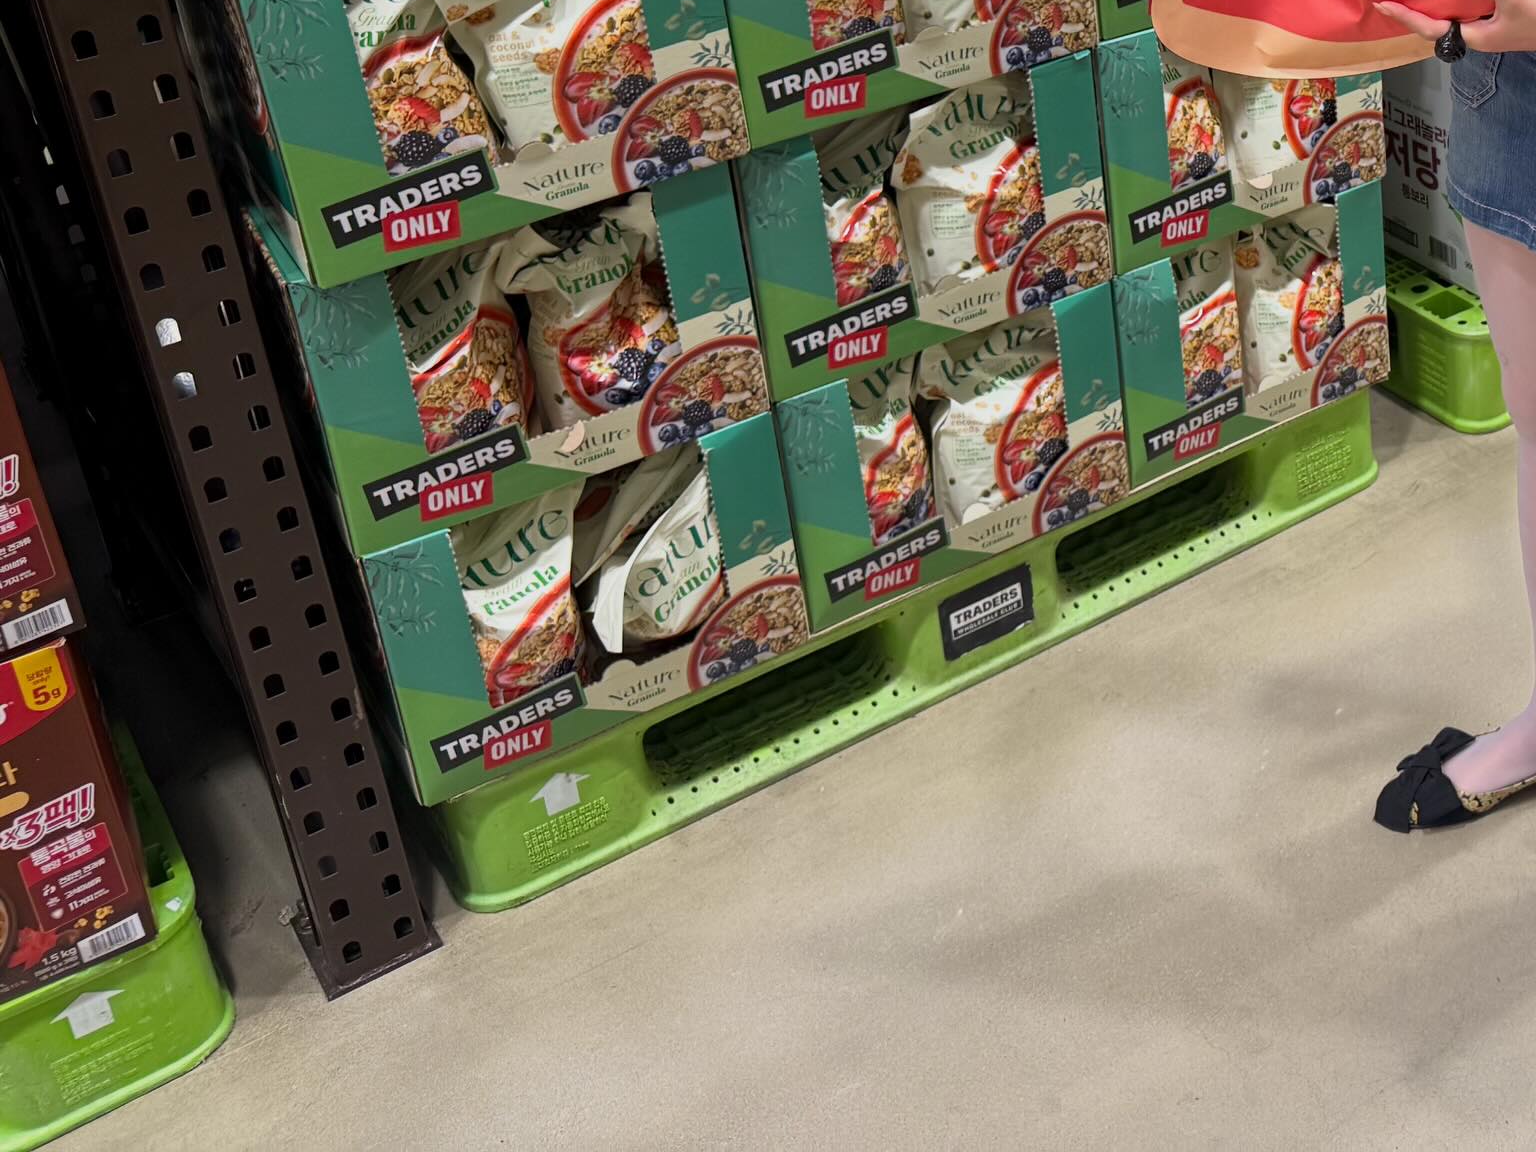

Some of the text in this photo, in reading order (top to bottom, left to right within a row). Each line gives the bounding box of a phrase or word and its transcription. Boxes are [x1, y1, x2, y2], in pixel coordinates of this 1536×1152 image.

[766, 43, 887, 99] TRADERS
[918, 47, 983, 72] Nature
[935, 64, 971, 80] Granola
[811, 82, 861, 111] ONLY
[523, 158, 605, 196] Nature
[545, 181, 591, 201] Granola
[333, 164, 484, 234] TRADERS
[1134, 183, 1227, 233] TRADERS
[390, 210, 451, 242] ONLY
[1166, 216, 1204, 240] ONLY
[555, 253, 634, 295] Granol
[792, 296, 909, 355] TRADERS
[953, 308, 987, 325] Granola
[834, 334, 882, 363] ONLY
[1149, 397, 1239, 452] TRADERS
[1179, 427, 1216, 454] ONLY
[574, 448, 616, 467] Granola
[373, 440, 516, 508] TRADERS
[427, 480, 485, 513] ONLY
[831, 529, 941, 593] TRADERS
[482, 563, 560, 616] ranola
[870, 563, 915, 593] ONLY
[954, 588, 1018, 625] TRADERS
[958, 602, 1018, 634] WHOLESALE CLUB
[32, 685, 62, 706] 5g
[626, 687, 666, 708] Granola
[440, 688, 574, 761] TRADERS
[491, 727, 544, 760] ONLY
[60, 947, 77, 963] kg
